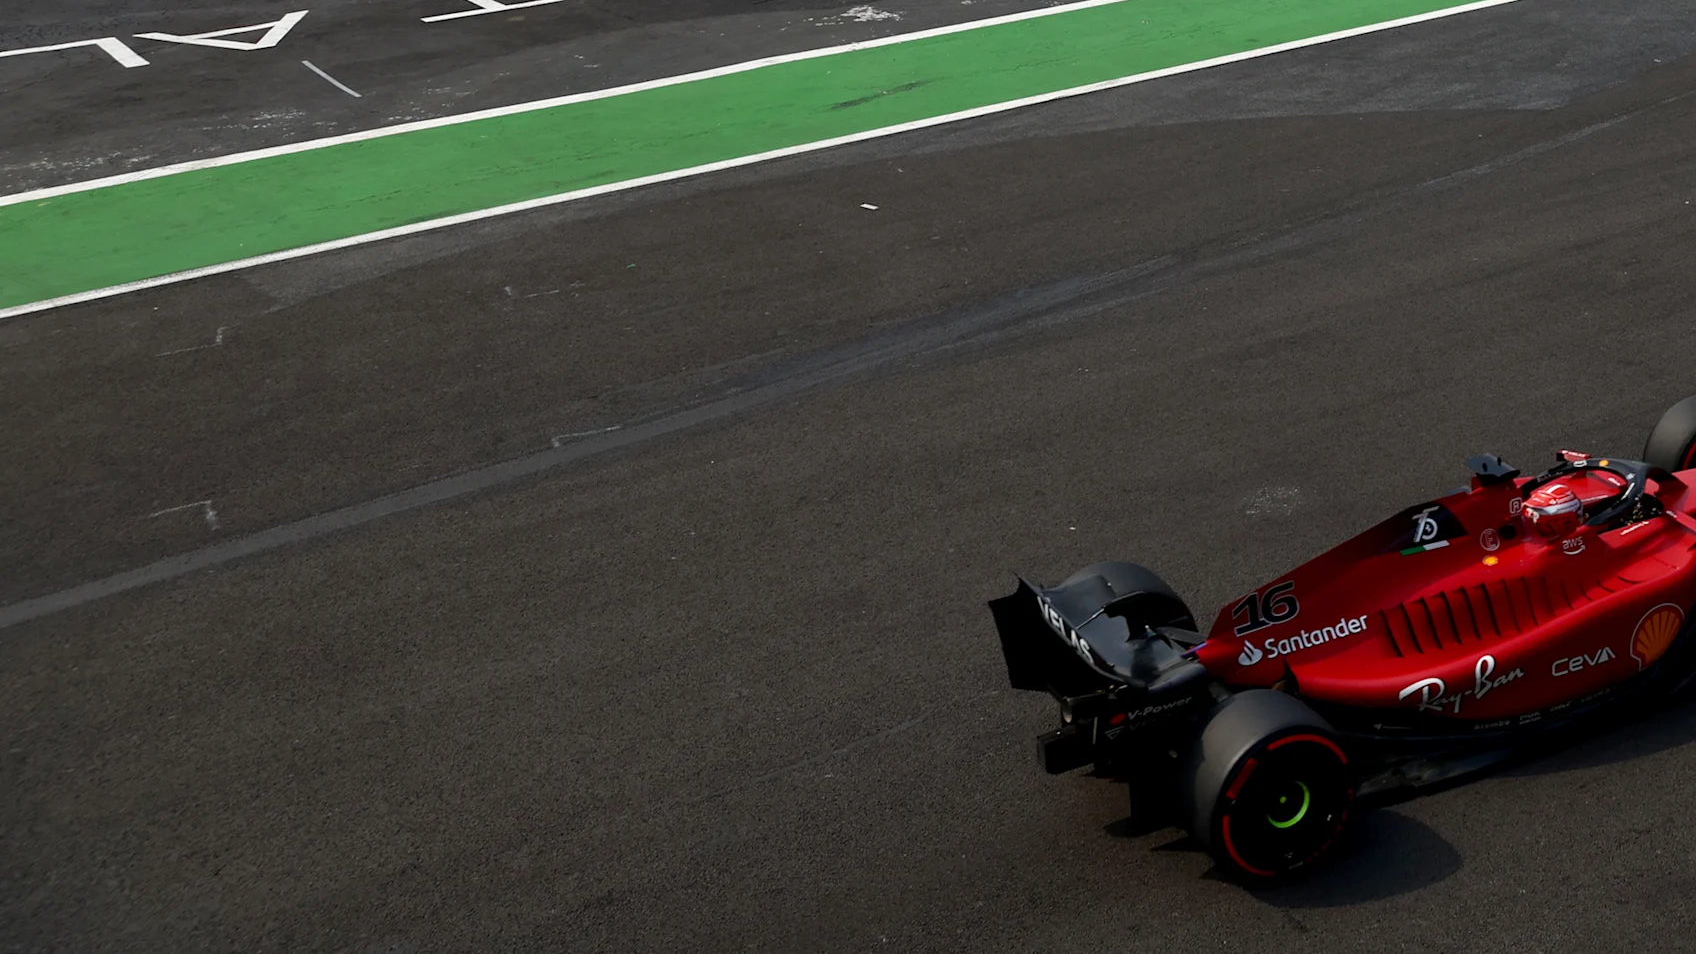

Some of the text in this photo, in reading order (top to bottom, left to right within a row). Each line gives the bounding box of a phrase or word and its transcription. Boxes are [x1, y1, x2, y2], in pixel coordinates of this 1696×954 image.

[1036, 595, 1094, 665] VELAS
[1231, 580, 1301, 637] 16
[1264, 614, 1369, 660] Santander
[1126, 696, 1193, 722] V-Power
[1398, 654, 1525, 714] Ray-Ban
